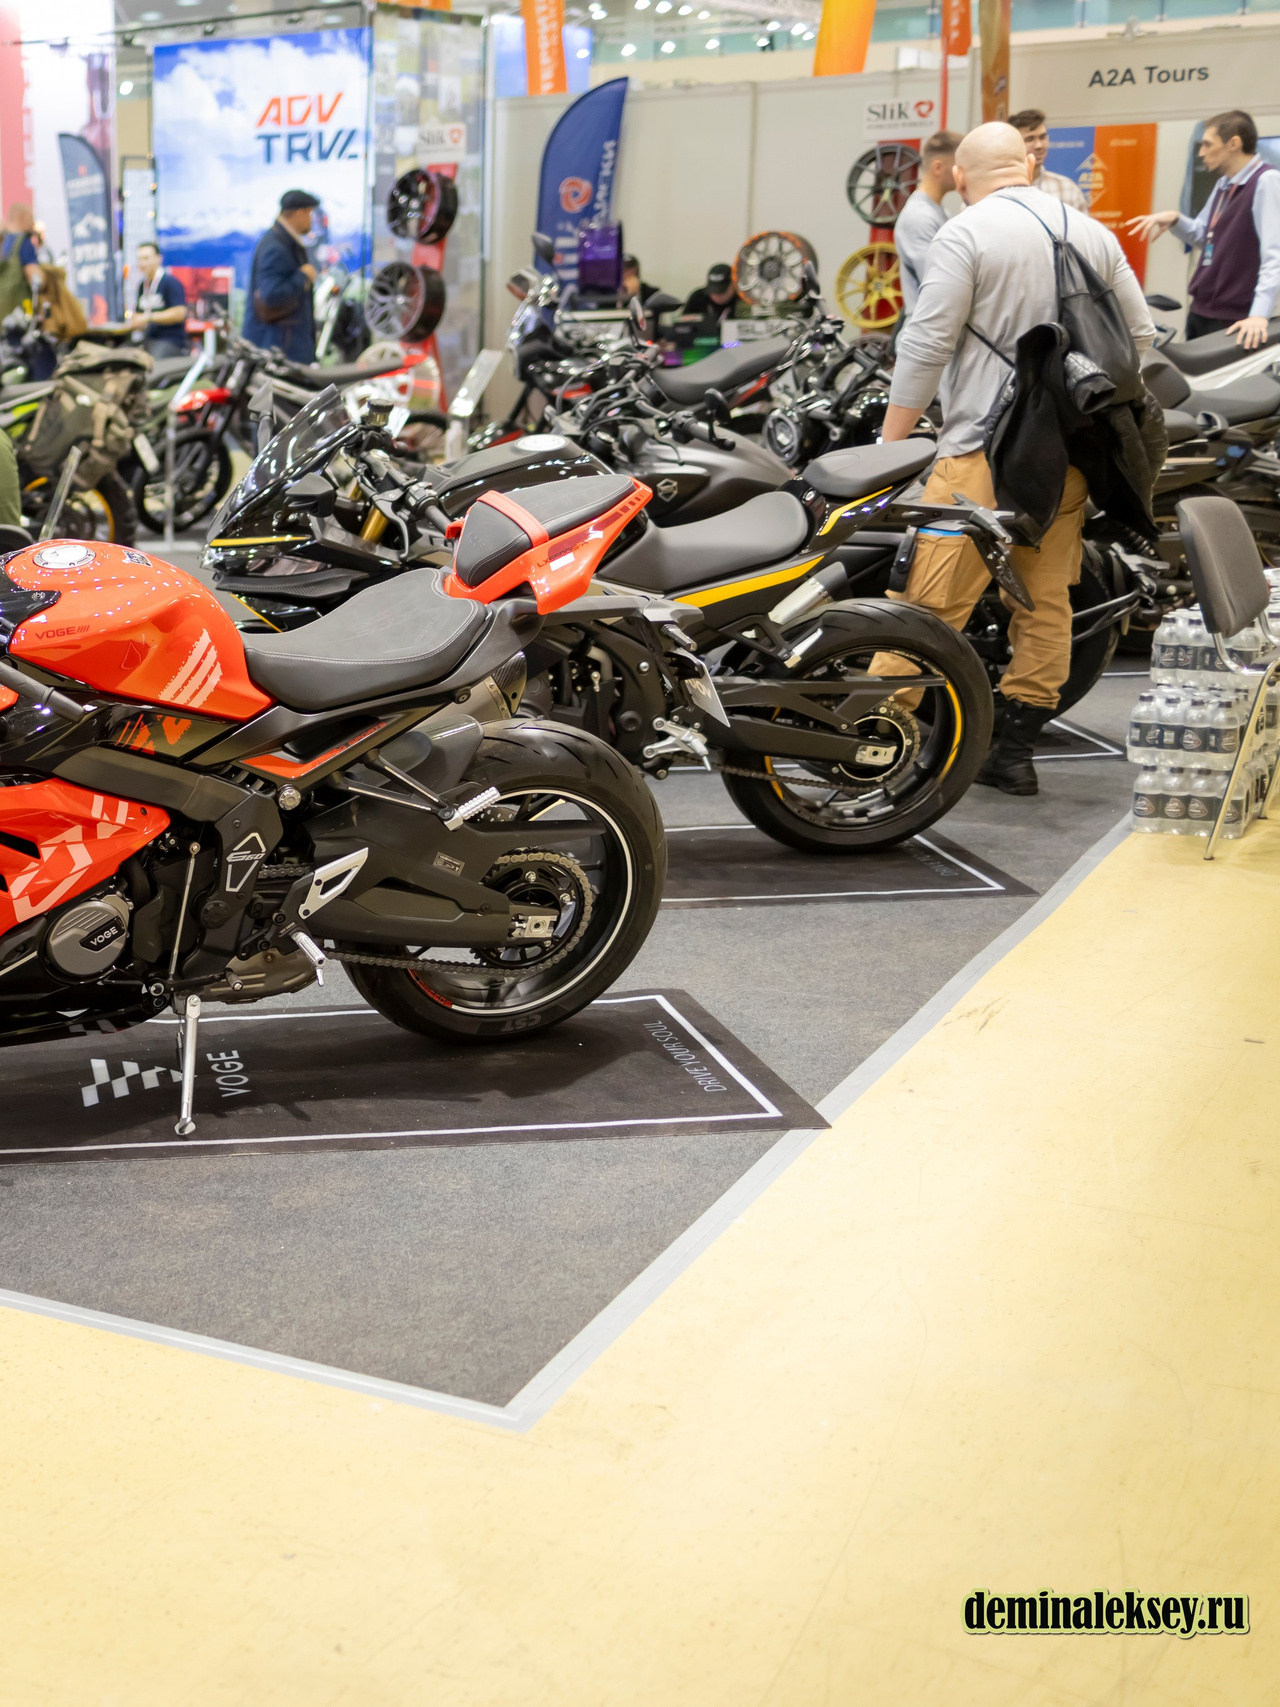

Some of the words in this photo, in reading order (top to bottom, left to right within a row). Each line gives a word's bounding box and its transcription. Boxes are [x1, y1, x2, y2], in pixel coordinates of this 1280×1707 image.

[1089, 68, 1136, 88] A2A
[1144, 66, 1209, 84] Tours
[256, 92, 343, 127] ADV
[35, 627, 76, 640] VOGE
[89, 926, 119, 947] VOGE
[501, 1014, 542, 1033] CST
[643, 1020, 679, 1042] SOUL
[663, 1042, 701, 1067] YOUR
[205, 1050, 252, 1098] VOGE
[685, 1066, 727, 1092] DRIVE
